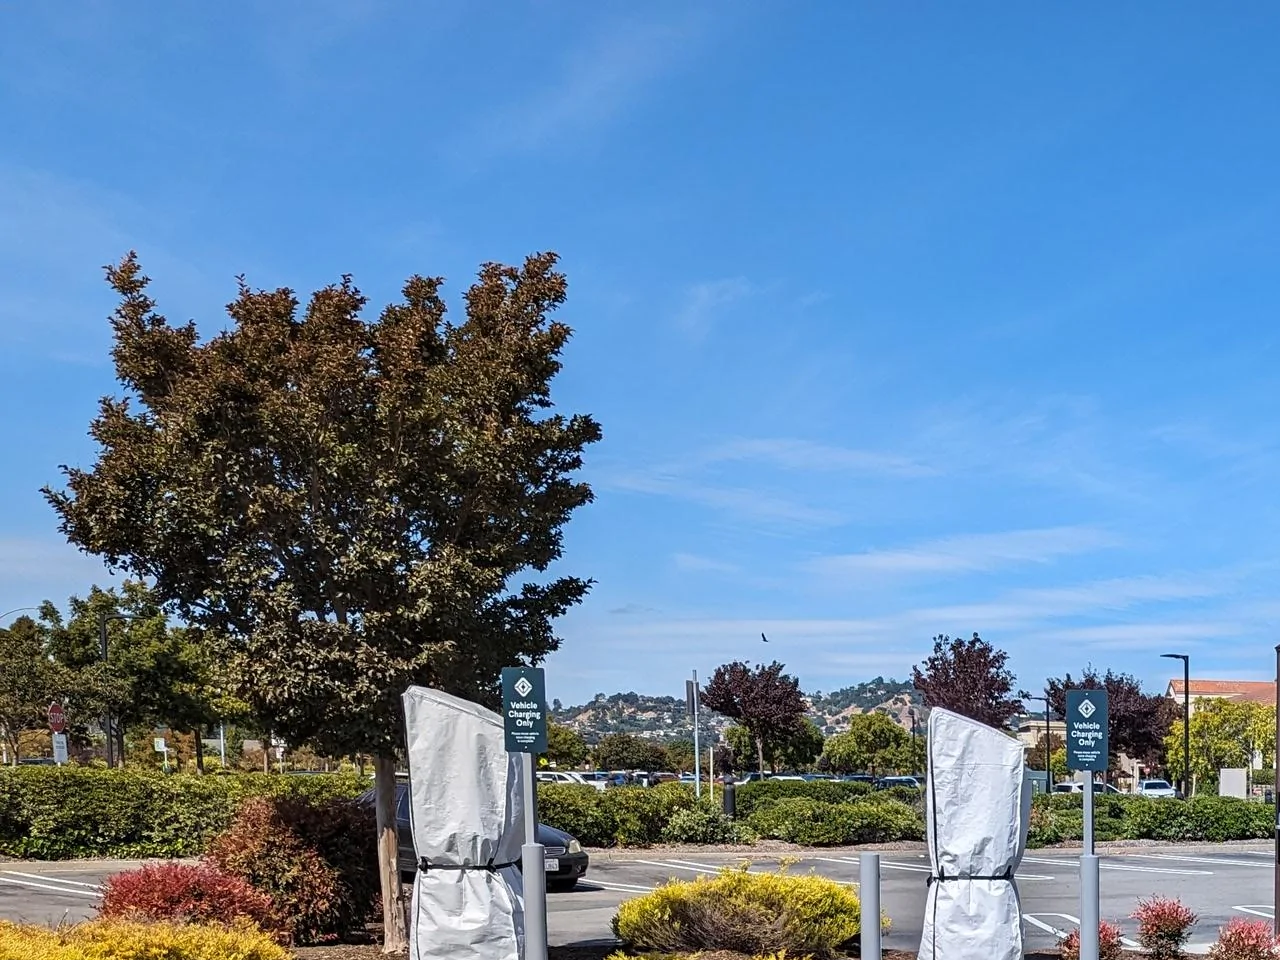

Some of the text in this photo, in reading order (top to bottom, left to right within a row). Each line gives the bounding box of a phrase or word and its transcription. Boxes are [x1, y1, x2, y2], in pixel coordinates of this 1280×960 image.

[510, 701, 538, 709] Vehicle
[50, 712, 64, 724] STOP
[508, 710, 541, 720] Charging
[516, 719, 534, 728] Only
[1073, 722, 1100, 730] Vehicle
[1071, 730, 1103, 739] Charging
[1078, 738, 1096, 747] Only
